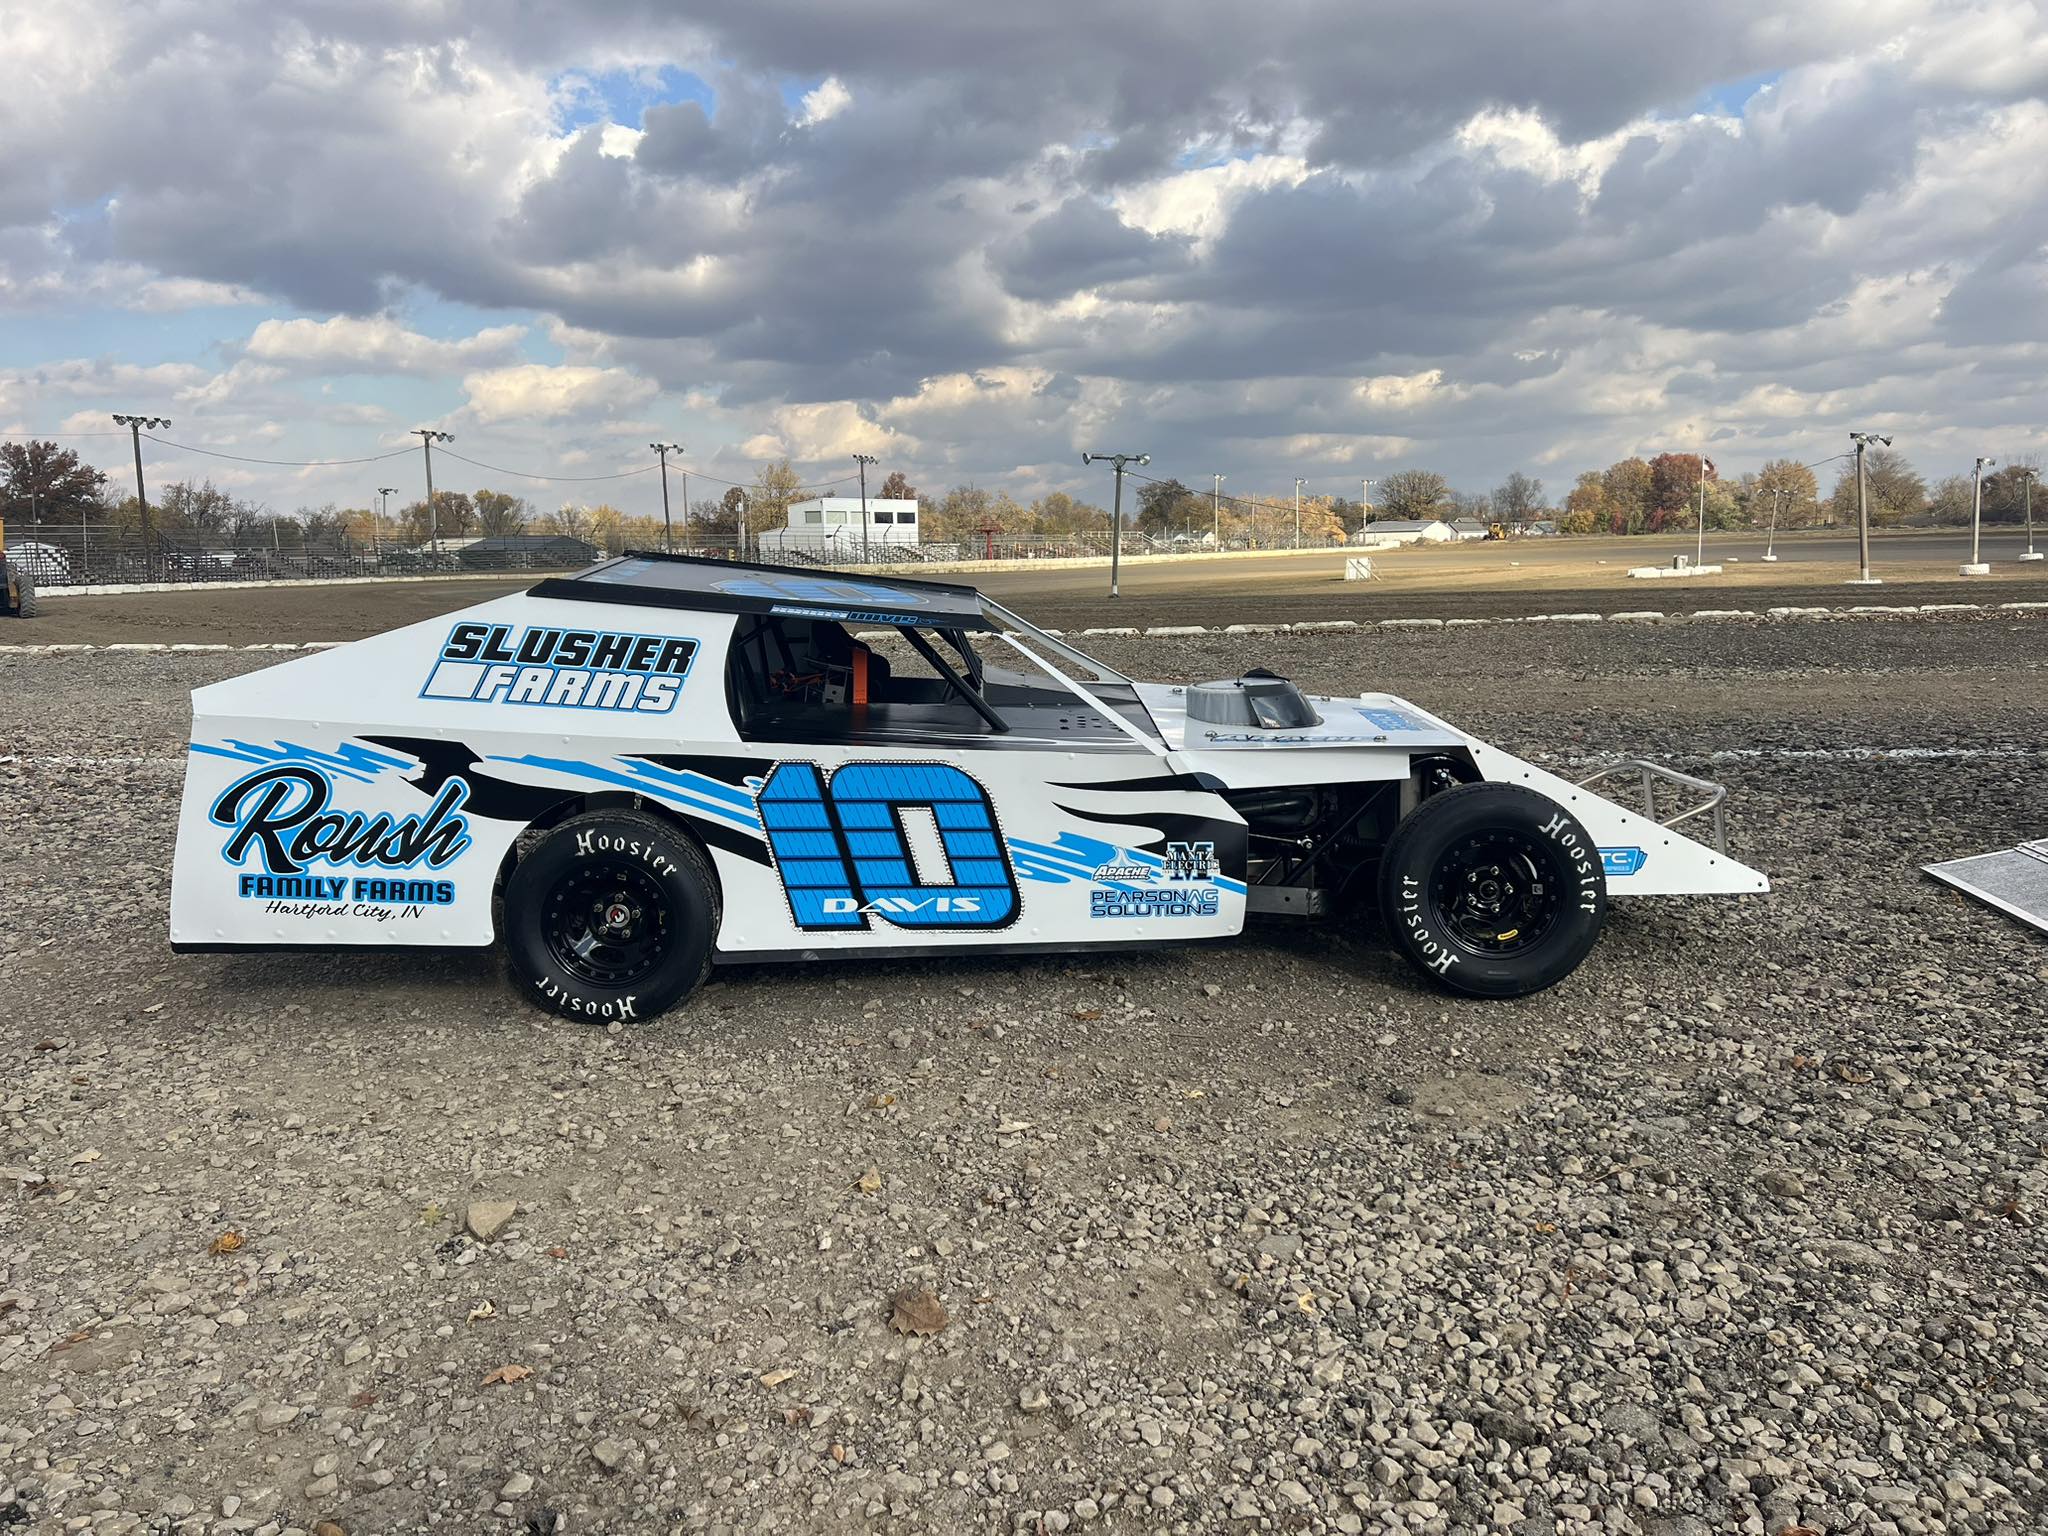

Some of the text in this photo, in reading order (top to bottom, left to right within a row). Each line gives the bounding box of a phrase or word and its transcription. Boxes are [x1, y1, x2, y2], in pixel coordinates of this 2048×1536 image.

[444, 624, 697, 673] SLUSHER
[474, 664, 682, 712] FARMS
[212, 766, 468, 874] Roush
[575, 828, 677, 876] Hoosier
[755, 761, 1024, 933] 10
[1094, 865, 1150, 876] APACHE
[1538, 811, 1600, 914] Hoosier
[241, 876, 452, 903] FAMILY FARMS
[264, 900, 425, 922] Hartford City, IN
[822, 897, 981, 913] DAVIS
[1092, 903, 1217, 915] SOLUTIONS
[1402, 875, 1461, 974] Hoosier
[535, 976, 637, 1020] Hoosier
